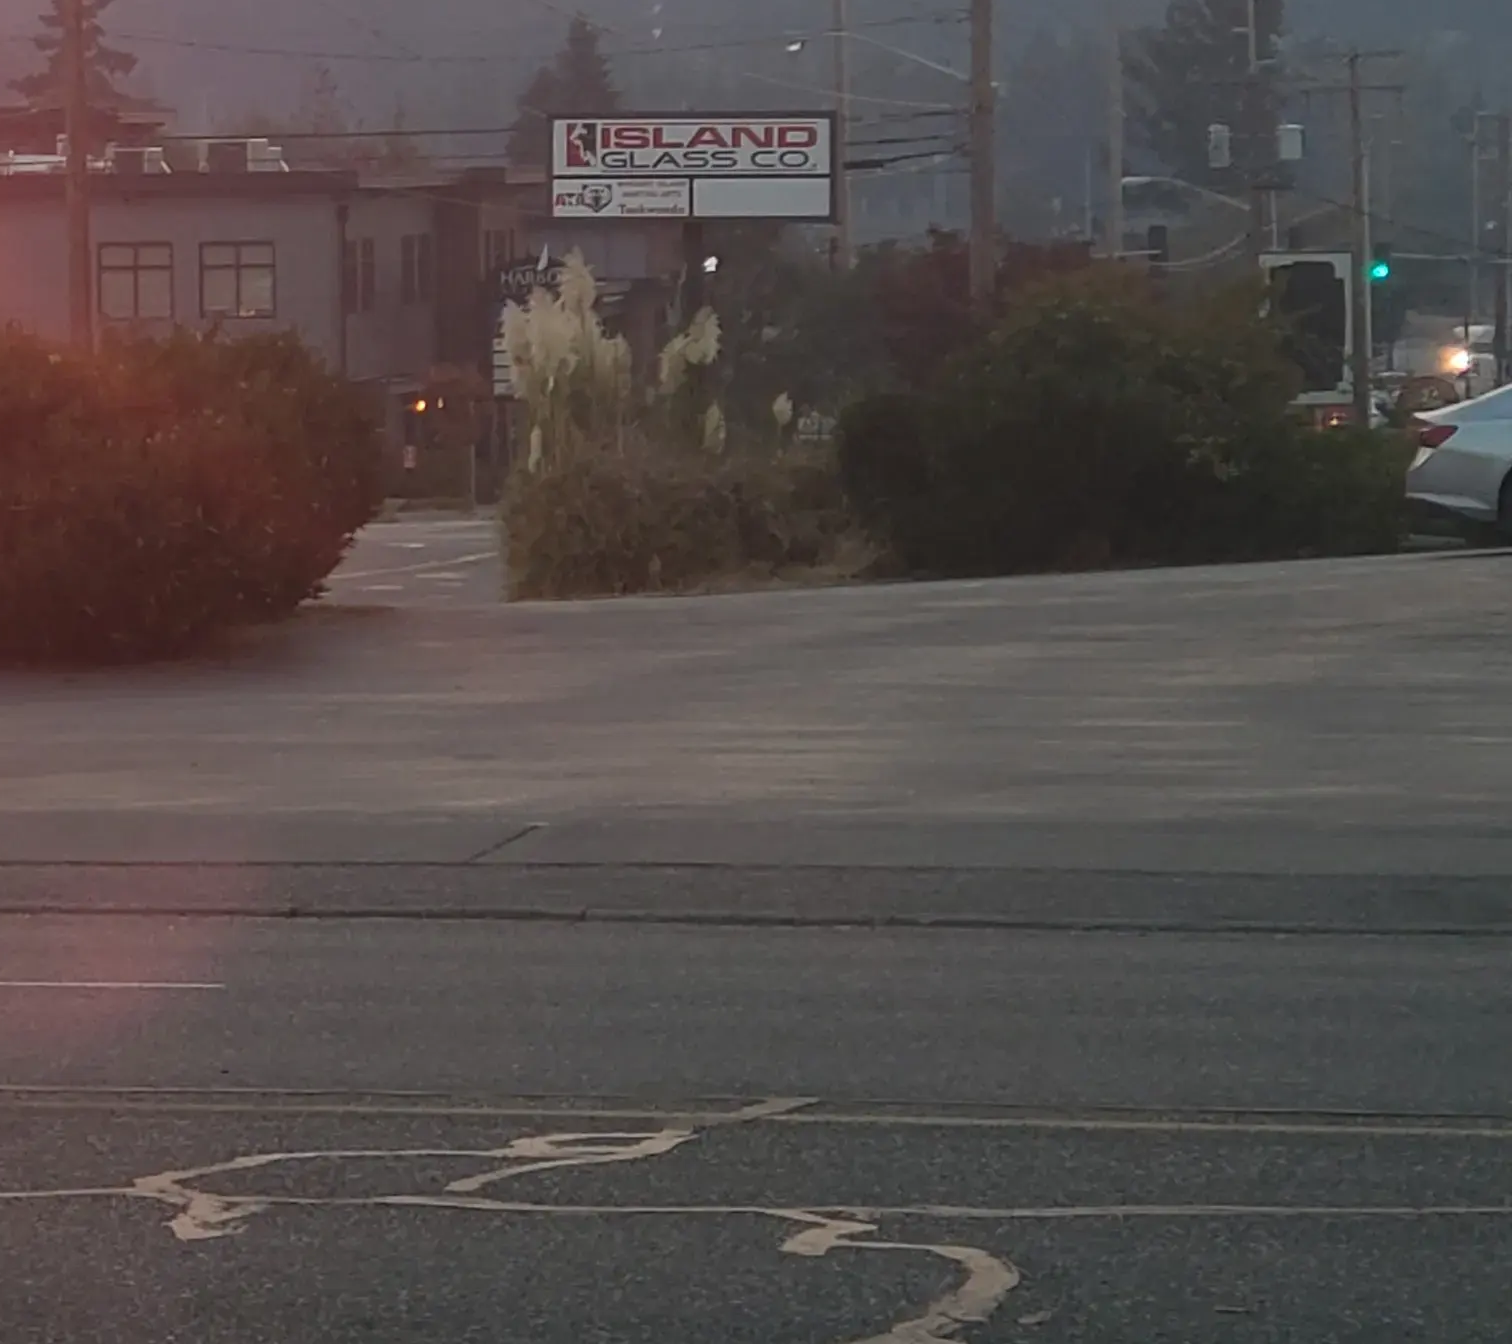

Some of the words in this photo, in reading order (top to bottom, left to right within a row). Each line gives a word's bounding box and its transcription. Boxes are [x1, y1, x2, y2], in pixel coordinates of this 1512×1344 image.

[601, 126, 818, 149] ISLAND
[600, 150, 738, 169] GLASS
[500, 269, 562, 286] HARBO
